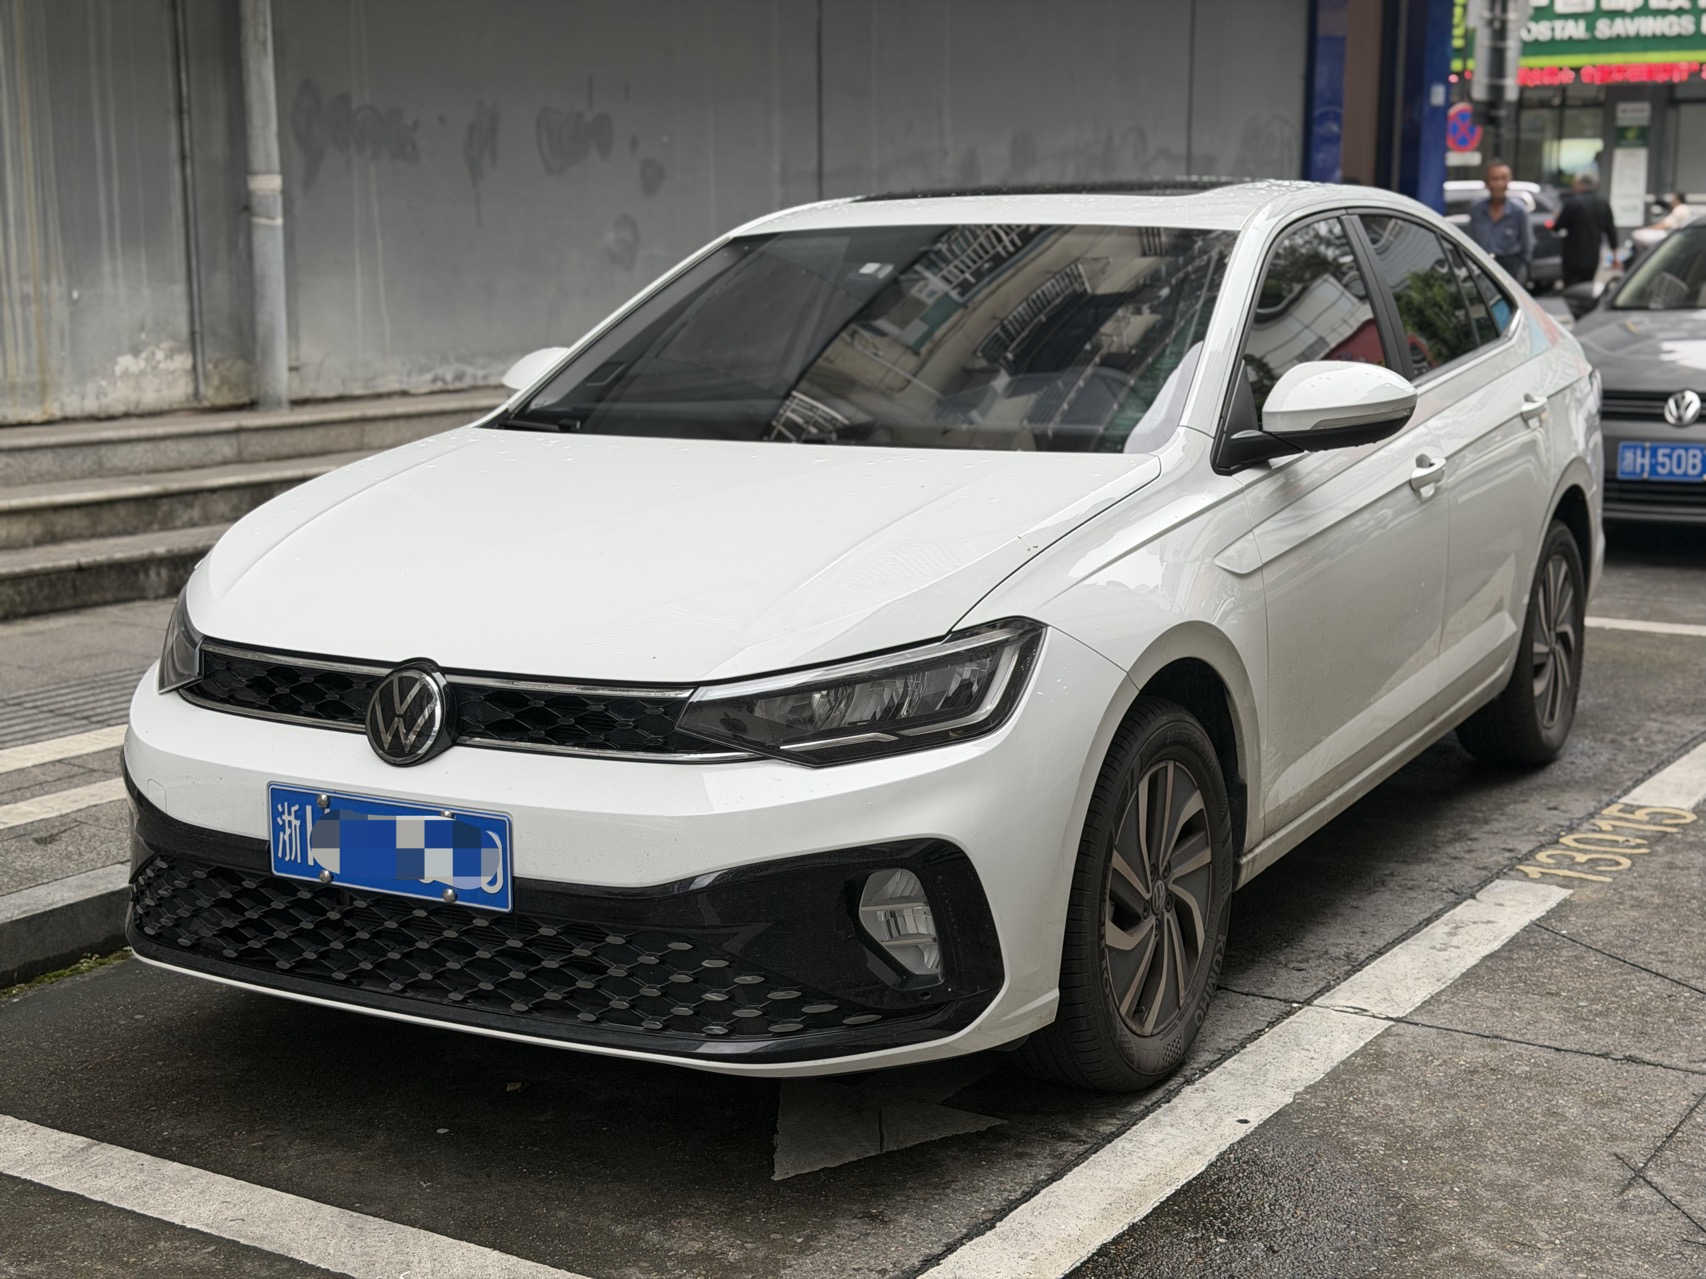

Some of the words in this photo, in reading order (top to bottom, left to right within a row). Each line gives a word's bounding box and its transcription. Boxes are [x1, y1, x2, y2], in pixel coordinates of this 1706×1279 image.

[1519, 20, 1590, 42] OSTAL
[1595, 15, 1696, 40] SAVINGS
[1622, 448, 1706, 476] H·50B
[1515, 803, 1697, 882] 13015
